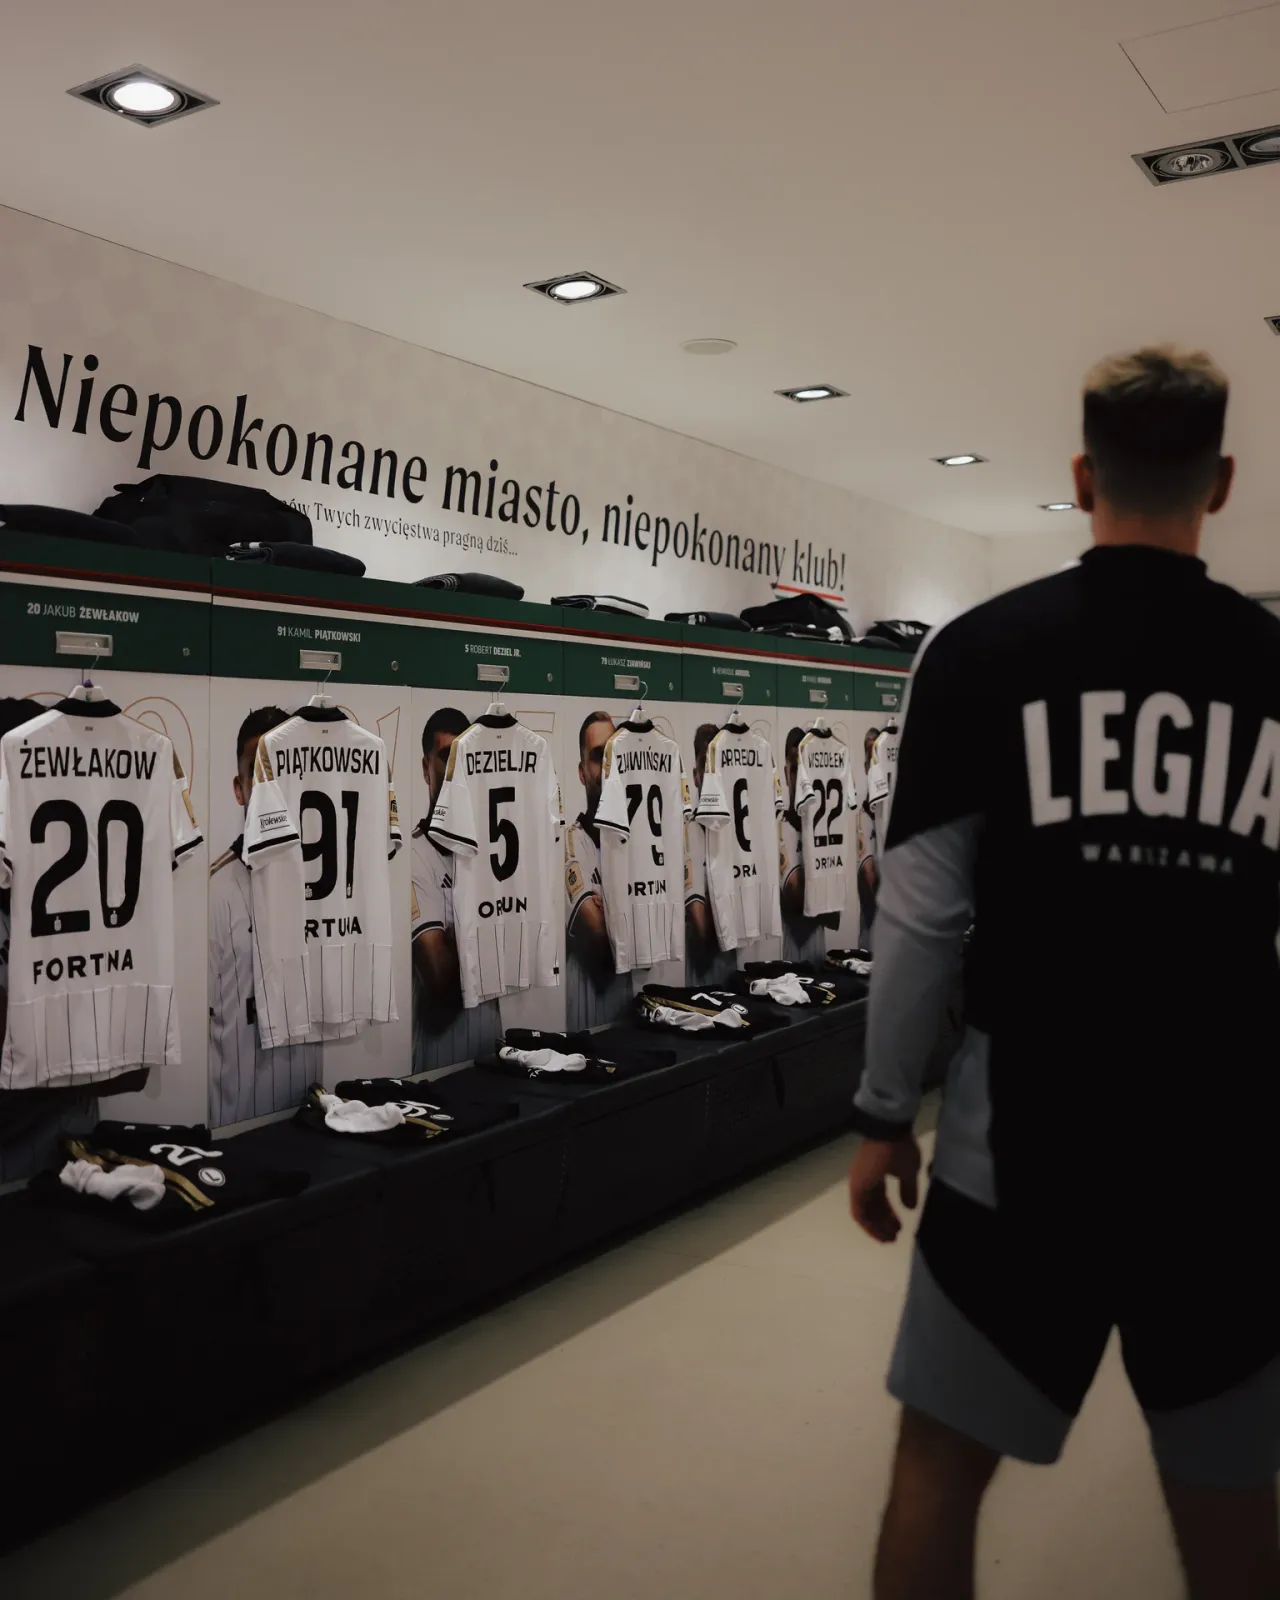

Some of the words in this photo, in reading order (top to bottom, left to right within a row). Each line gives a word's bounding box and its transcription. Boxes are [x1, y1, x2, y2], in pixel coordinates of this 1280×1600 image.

[14, 344, 428, 504] Niepokonane
[441, 458, 591, 546] miasto,
[602, 494, 788, 583] niepokonany
[793, 538, 848, 592] klub!
[314, 502, 360, 528] Twych
[363, 514, 440, 541] zwycięstwa
[443, 531, 484, 554] pragną
[26, 602, 41, 615] 20
[42, 603, 77, 618] JAKUB
[79, 606, 140, 623] ŻEWŁAKOW
[277, 625, 287, 637] 91
[288, 627, 312, 639] KAMIL
[314, 629, 361, 643] PIĄTKOWSKI
[20, 738, 158, 780] ŻEWŁAKOW
[275, 746, 380, 781] PIĄTKOWSKI
[465, 749, 518, 776] DEZIEL
[1022, 689, 1280, 852] LEGIA
[488, 786, 520, 882] 5
[812, 778, 844, 848] 22
[30, 799, 145, 938] 20
[299, 790, 360, 901] 91
[33, 948, 133, 985] FORTNA
